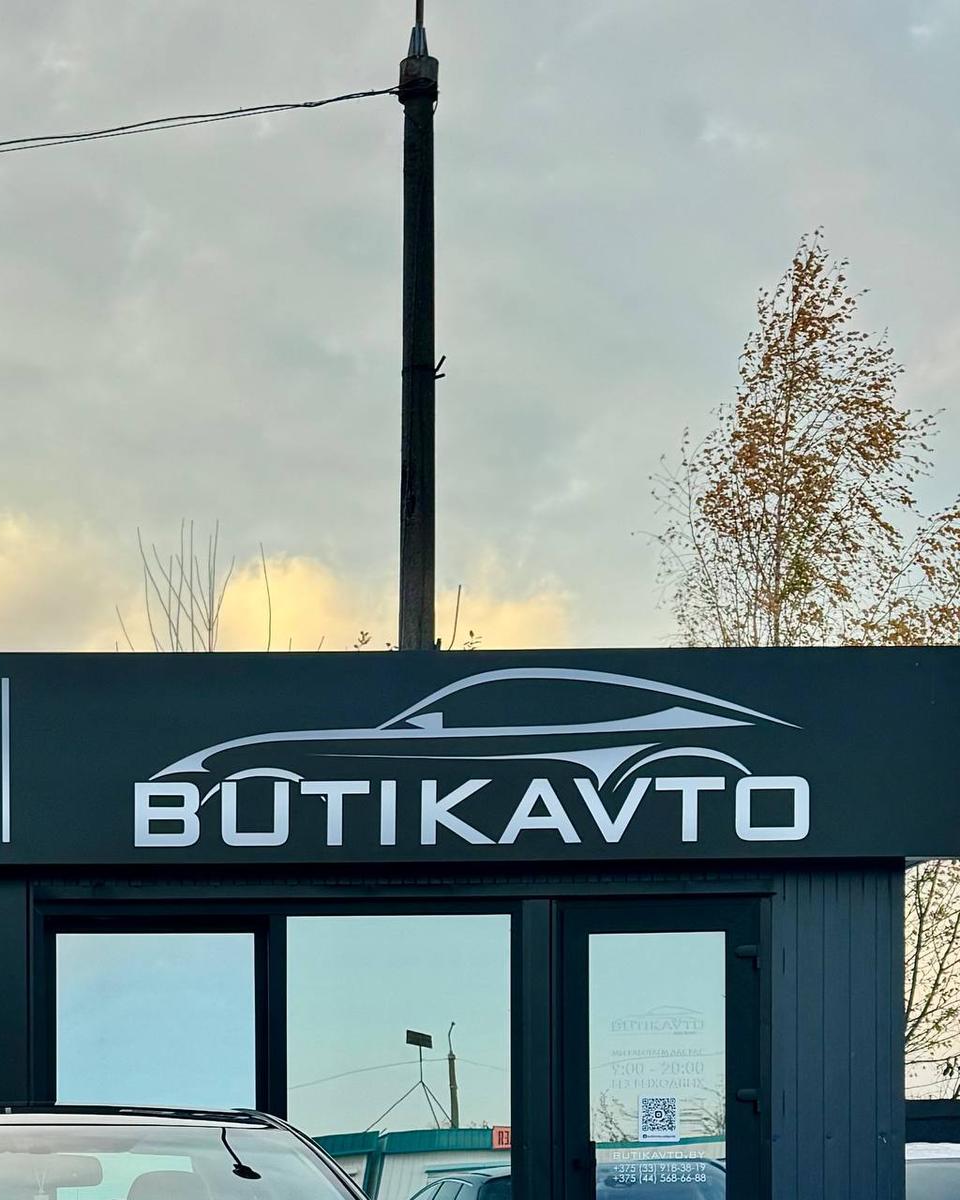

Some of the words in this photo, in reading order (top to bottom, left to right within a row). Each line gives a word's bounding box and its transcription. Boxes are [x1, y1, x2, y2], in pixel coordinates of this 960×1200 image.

[134, 775, 810, 848] BUTIKAVTO
[613, 1163, 636, 1172] +375
[639, 1163, 657, 1174] (33)
[613, 1174, 636, 1182] +375
[639, 1173, 657, 1184] (44)
[660, 1174, 706, 1182] 568-66-88
